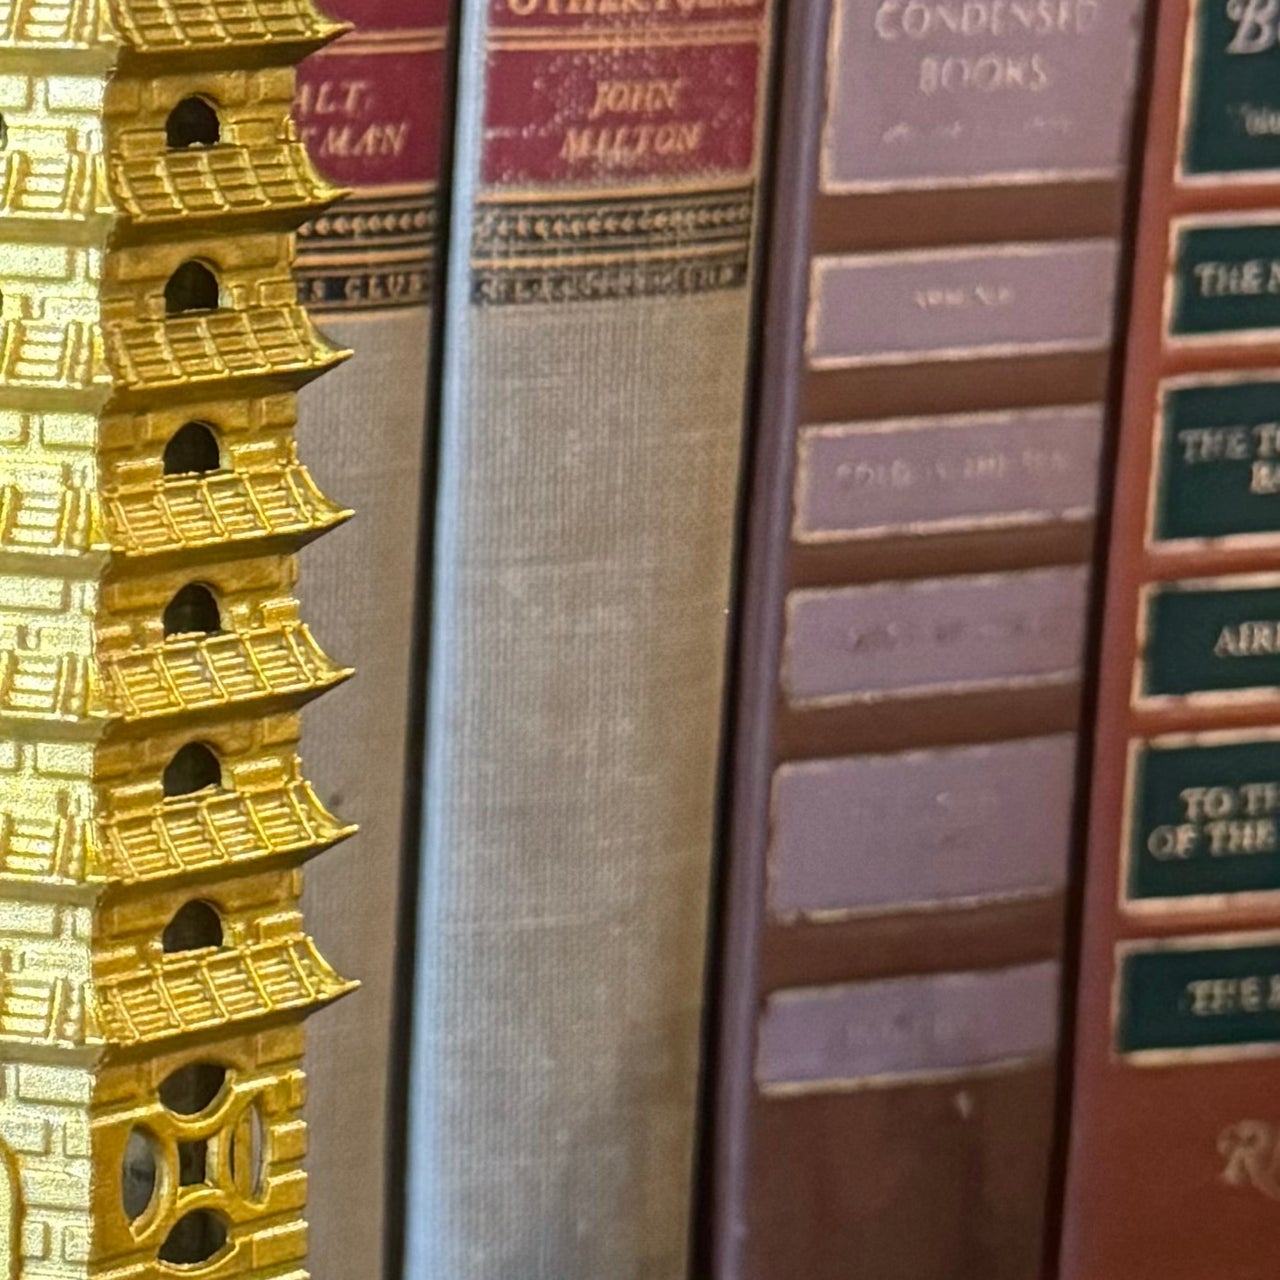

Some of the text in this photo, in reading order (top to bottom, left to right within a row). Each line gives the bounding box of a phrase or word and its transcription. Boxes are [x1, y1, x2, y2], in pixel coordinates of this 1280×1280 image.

[591, 78, 681, 117] JOHN
[560, 122, 704, 162] MILTON
[1179, 786, 1232, 820] TO
[1147, 823, 1197, 861] OF
